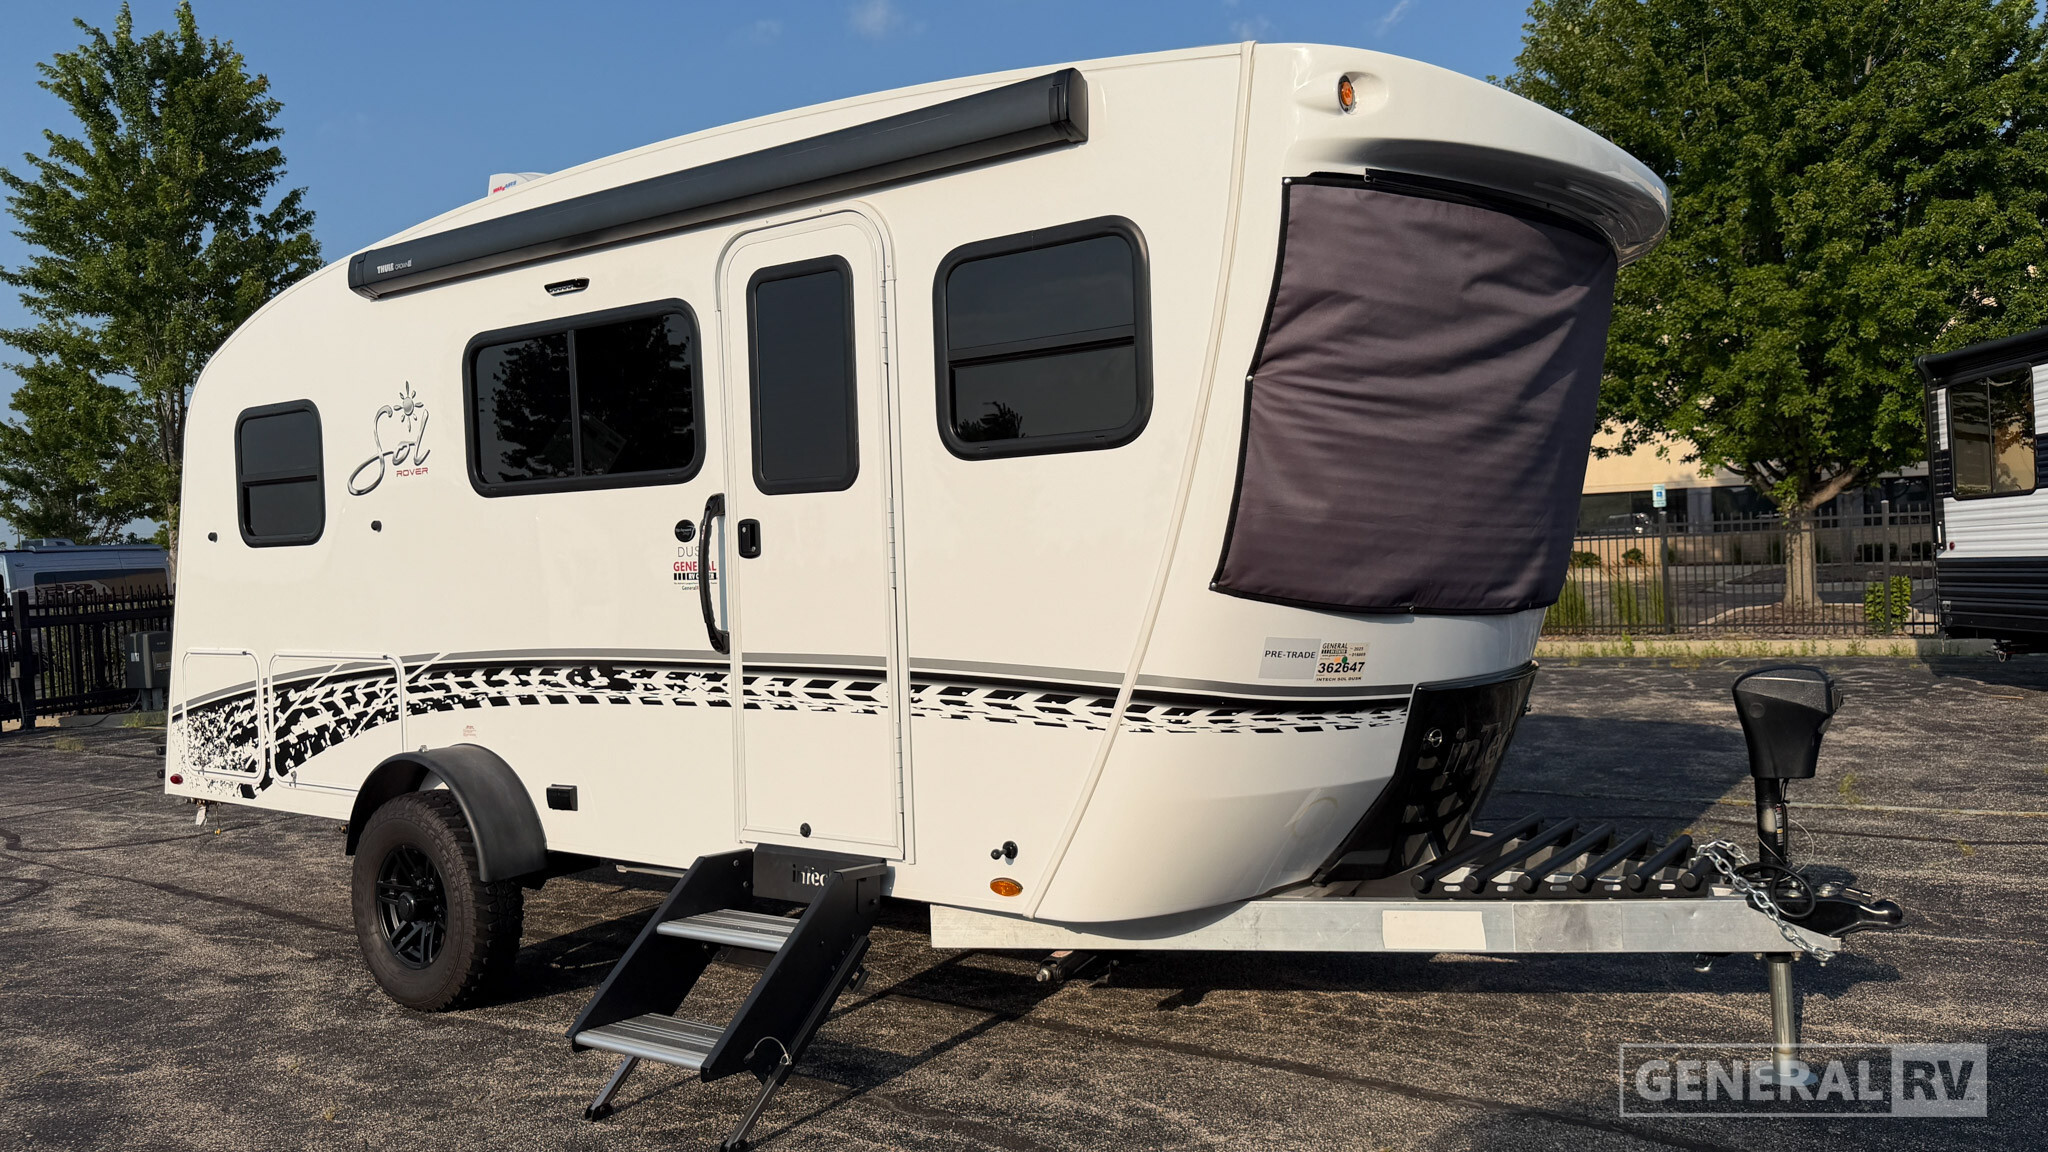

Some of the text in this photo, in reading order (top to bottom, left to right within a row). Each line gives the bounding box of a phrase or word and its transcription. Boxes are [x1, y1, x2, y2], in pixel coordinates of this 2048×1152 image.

[376, 262, 394, 274] THULE
[396, 467, 429, 477] ROVER
[677, 546, 700, 557] DUS
[673, 561, 717, 572] GENEL
[1264, 650, 1316, 659] PRE-TRADE
[1317, 661, 1366, 673] 362647
